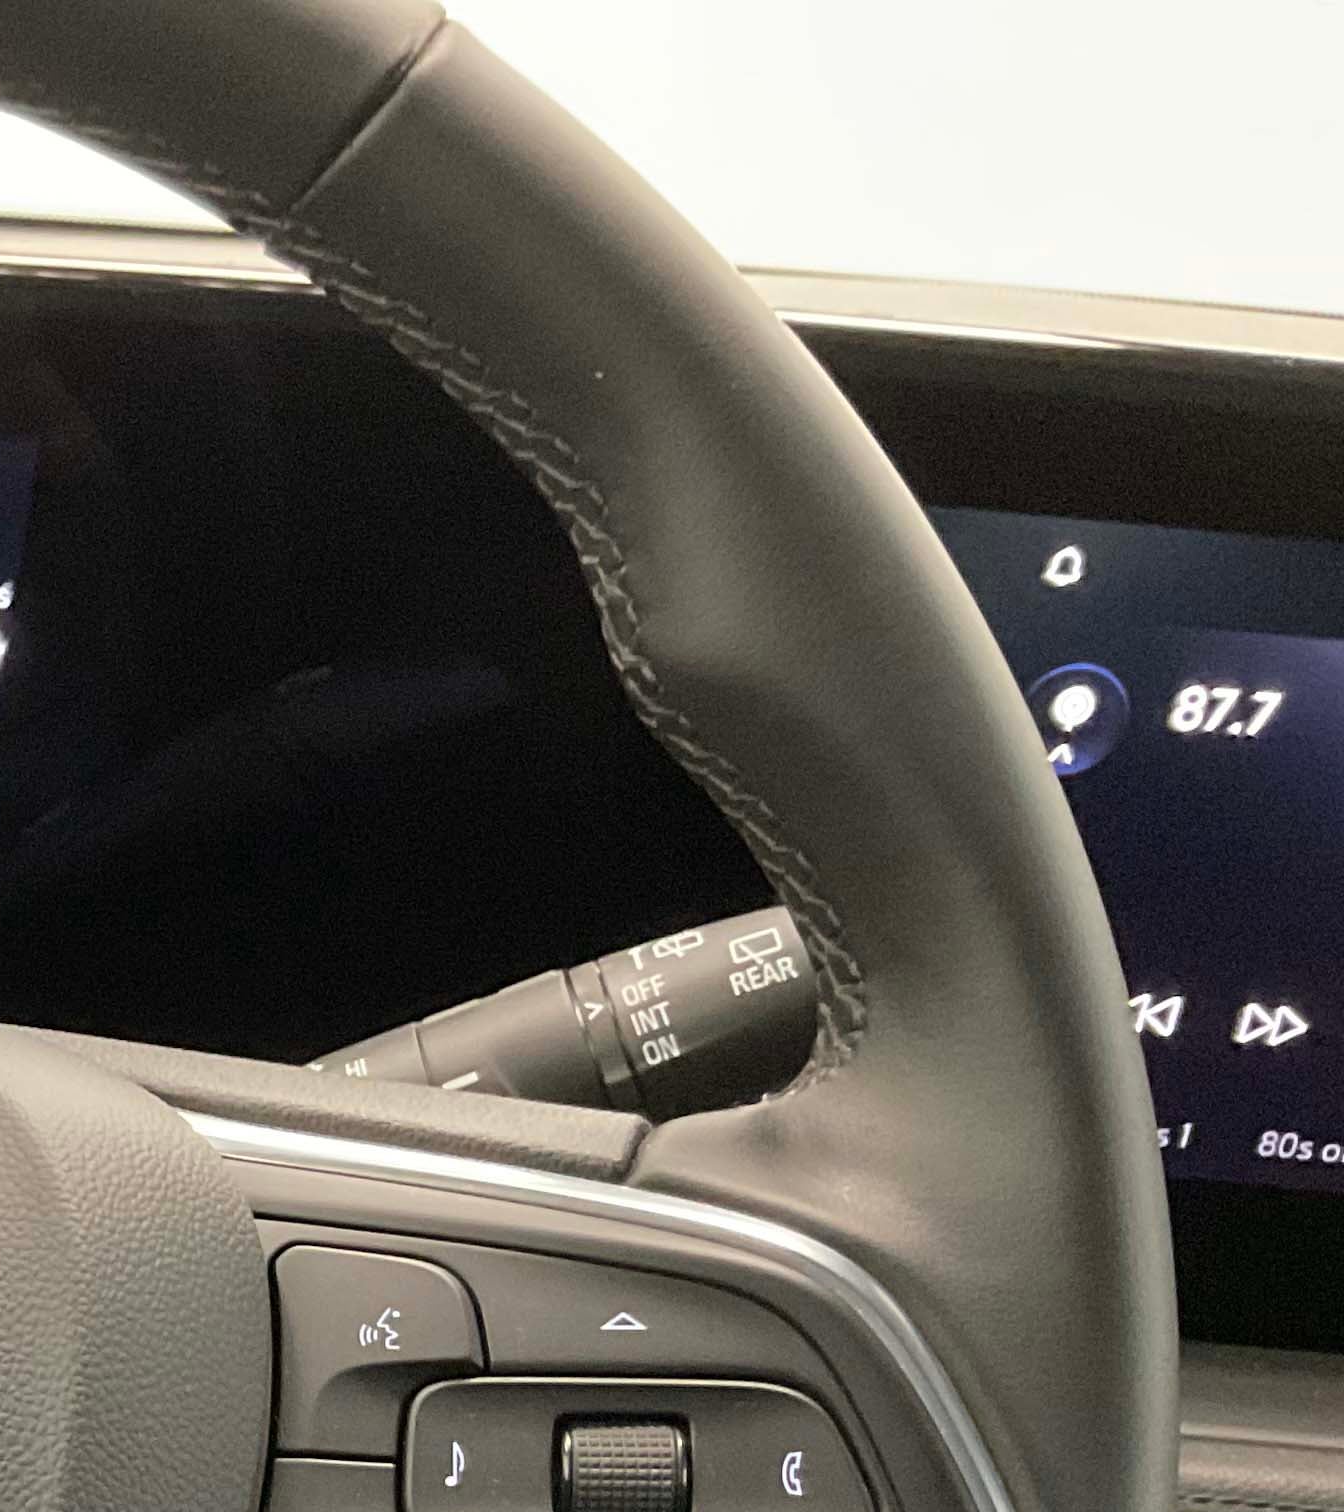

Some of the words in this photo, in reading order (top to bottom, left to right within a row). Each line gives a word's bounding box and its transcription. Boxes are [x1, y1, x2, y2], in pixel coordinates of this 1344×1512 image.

[1168, 683, 1285, 739] 87.7
[621, 973, 666, 1008] OFF
[728, 955, 800, 997] REAR
[629, 1001, 672, 1037] INT
[641, 1033, 682, 1066] ON
[1256, 1129, 1315, 1162] 80s
[1320, 1142, 1344, 1163] o
